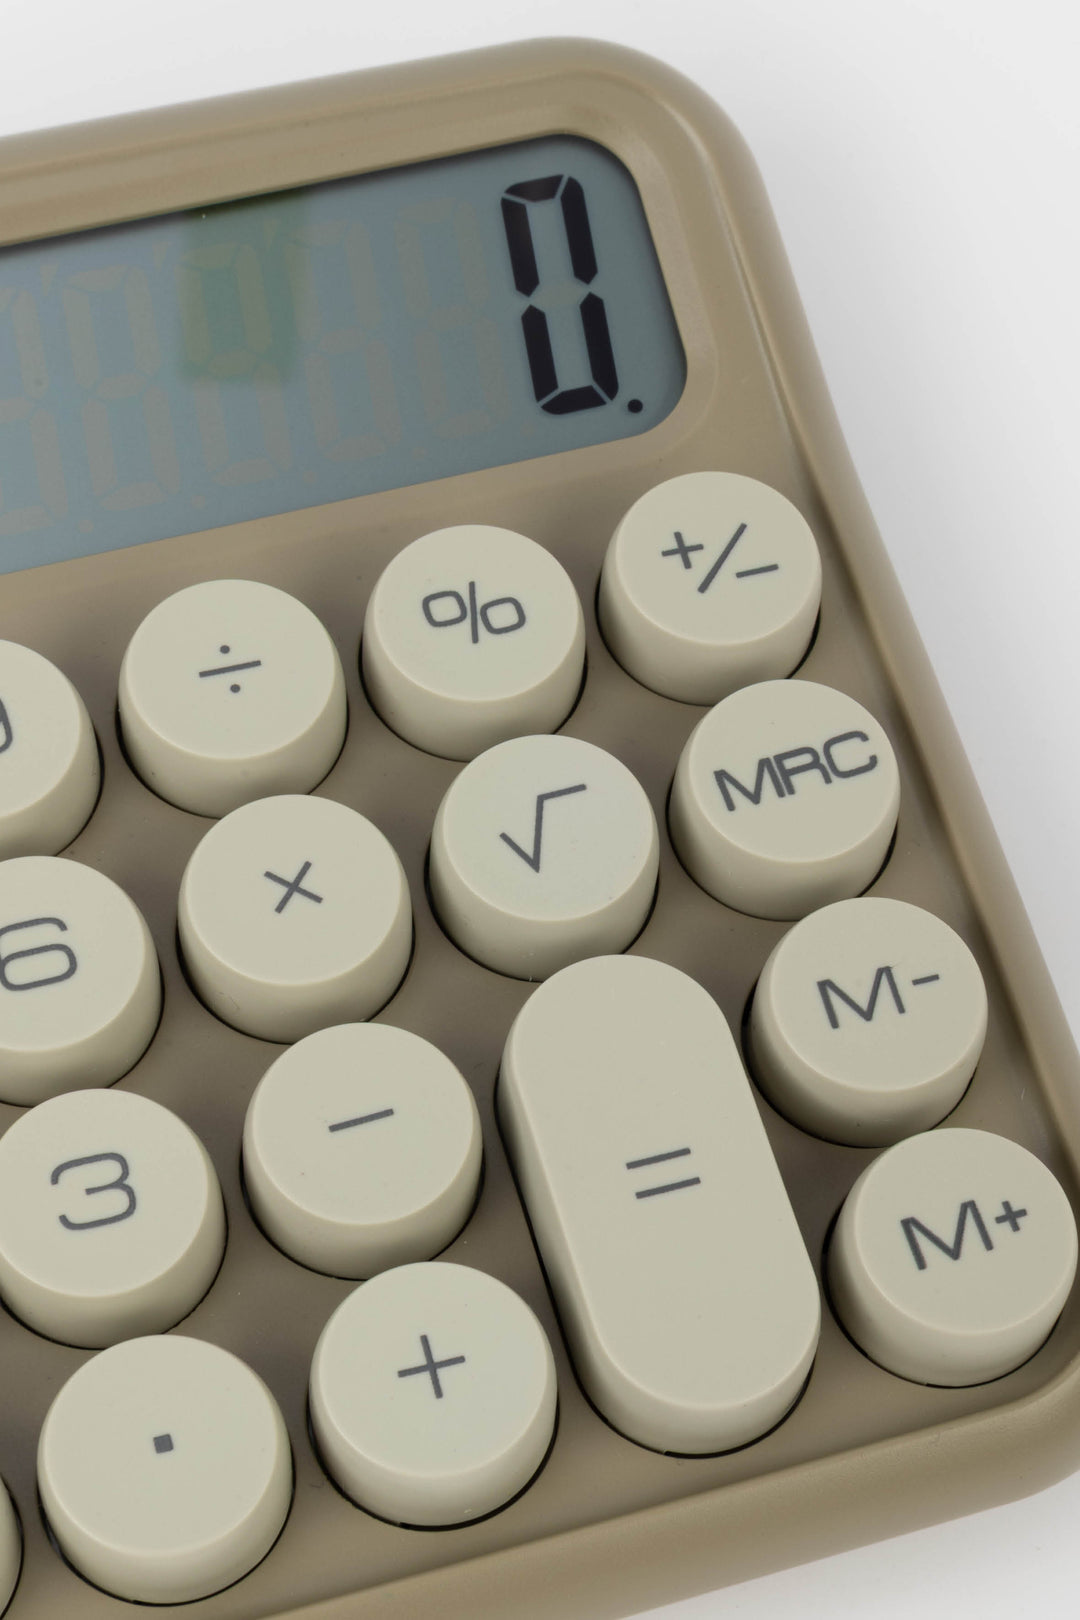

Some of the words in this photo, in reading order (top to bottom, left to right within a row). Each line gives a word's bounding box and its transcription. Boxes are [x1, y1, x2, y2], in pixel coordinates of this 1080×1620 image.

[501, 174, 643, 415] 0.
[662, 523, 779, 593] +/-
[422, 581, 526, 644] %
[714, 731, 878, 811] MRC
[0, 918, 77, 991] 6
[817, 966, 939, 1029] M-
[51, 1153, 136, 1230] 3
[626, 1148, 701, 1199] =
[900, 1200, 1027, 1270] M+
[398, 1335, 465, 1398] +
